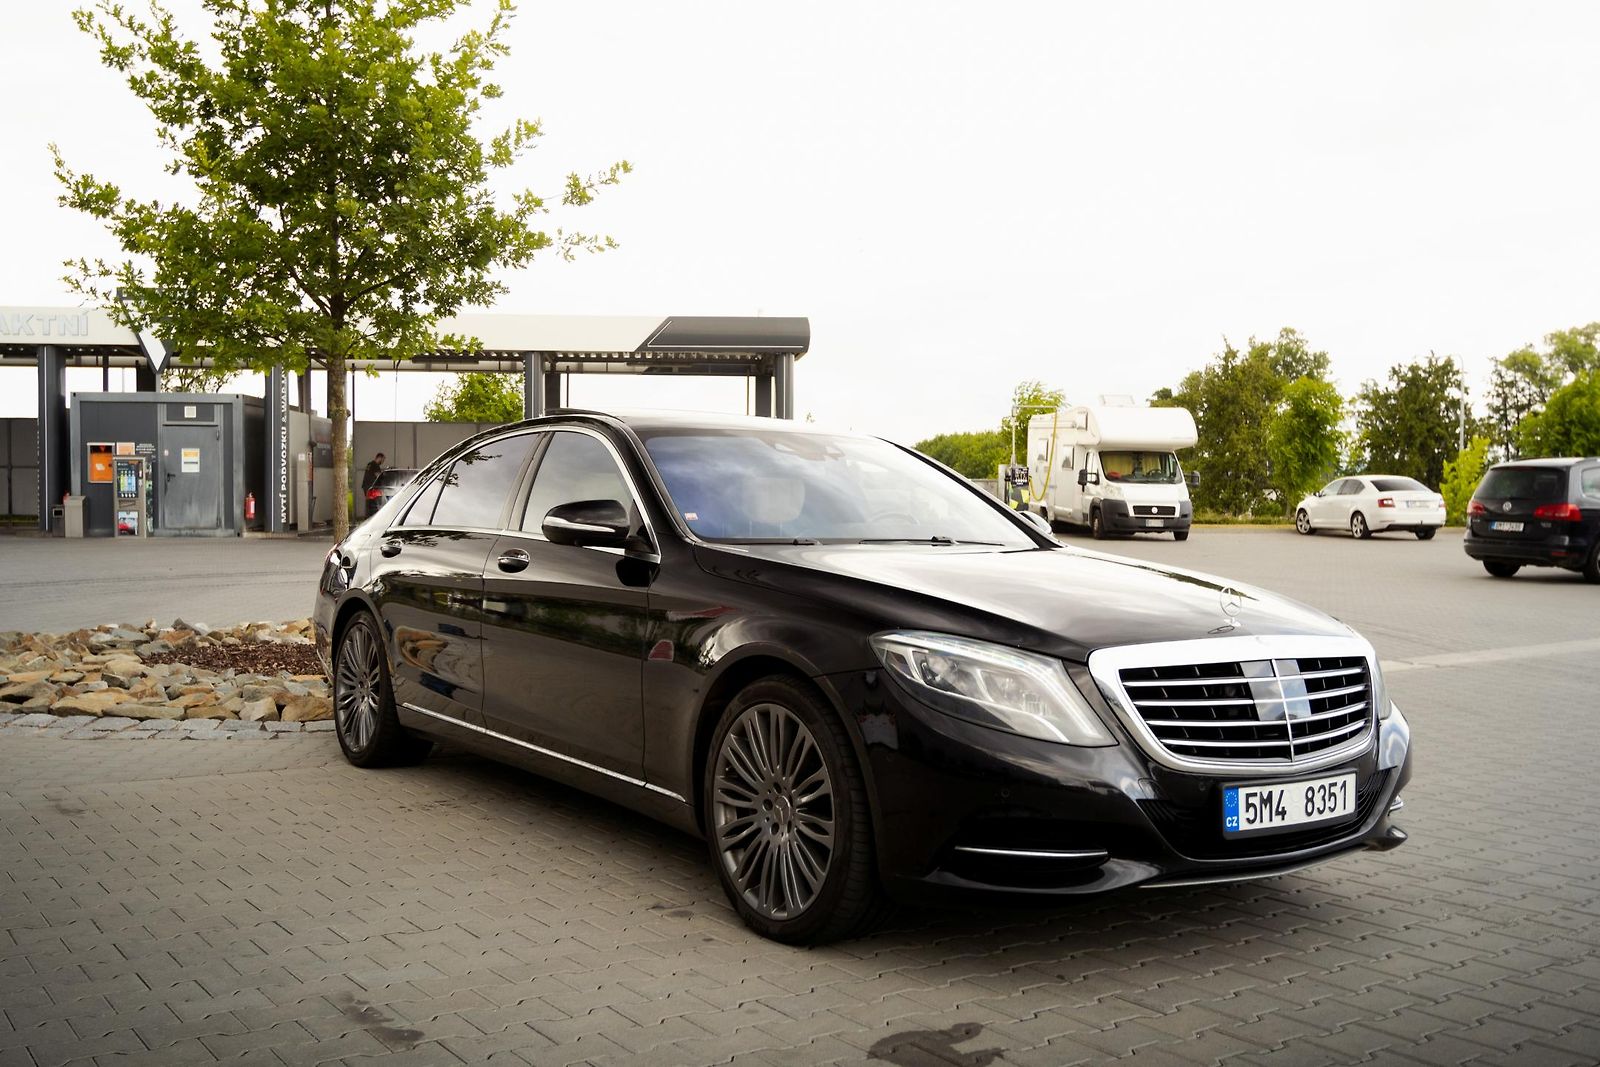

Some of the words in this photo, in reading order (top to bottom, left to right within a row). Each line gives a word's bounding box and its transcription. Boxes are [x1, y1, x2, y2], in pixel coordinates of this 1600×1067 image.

[279, 493, 287, 523] MYTÍ
[1245, 789, 1287, 825] 5M4
[1305, 780, 1347, 817] 8351
[1226, 816, 1238, 828] CZ
